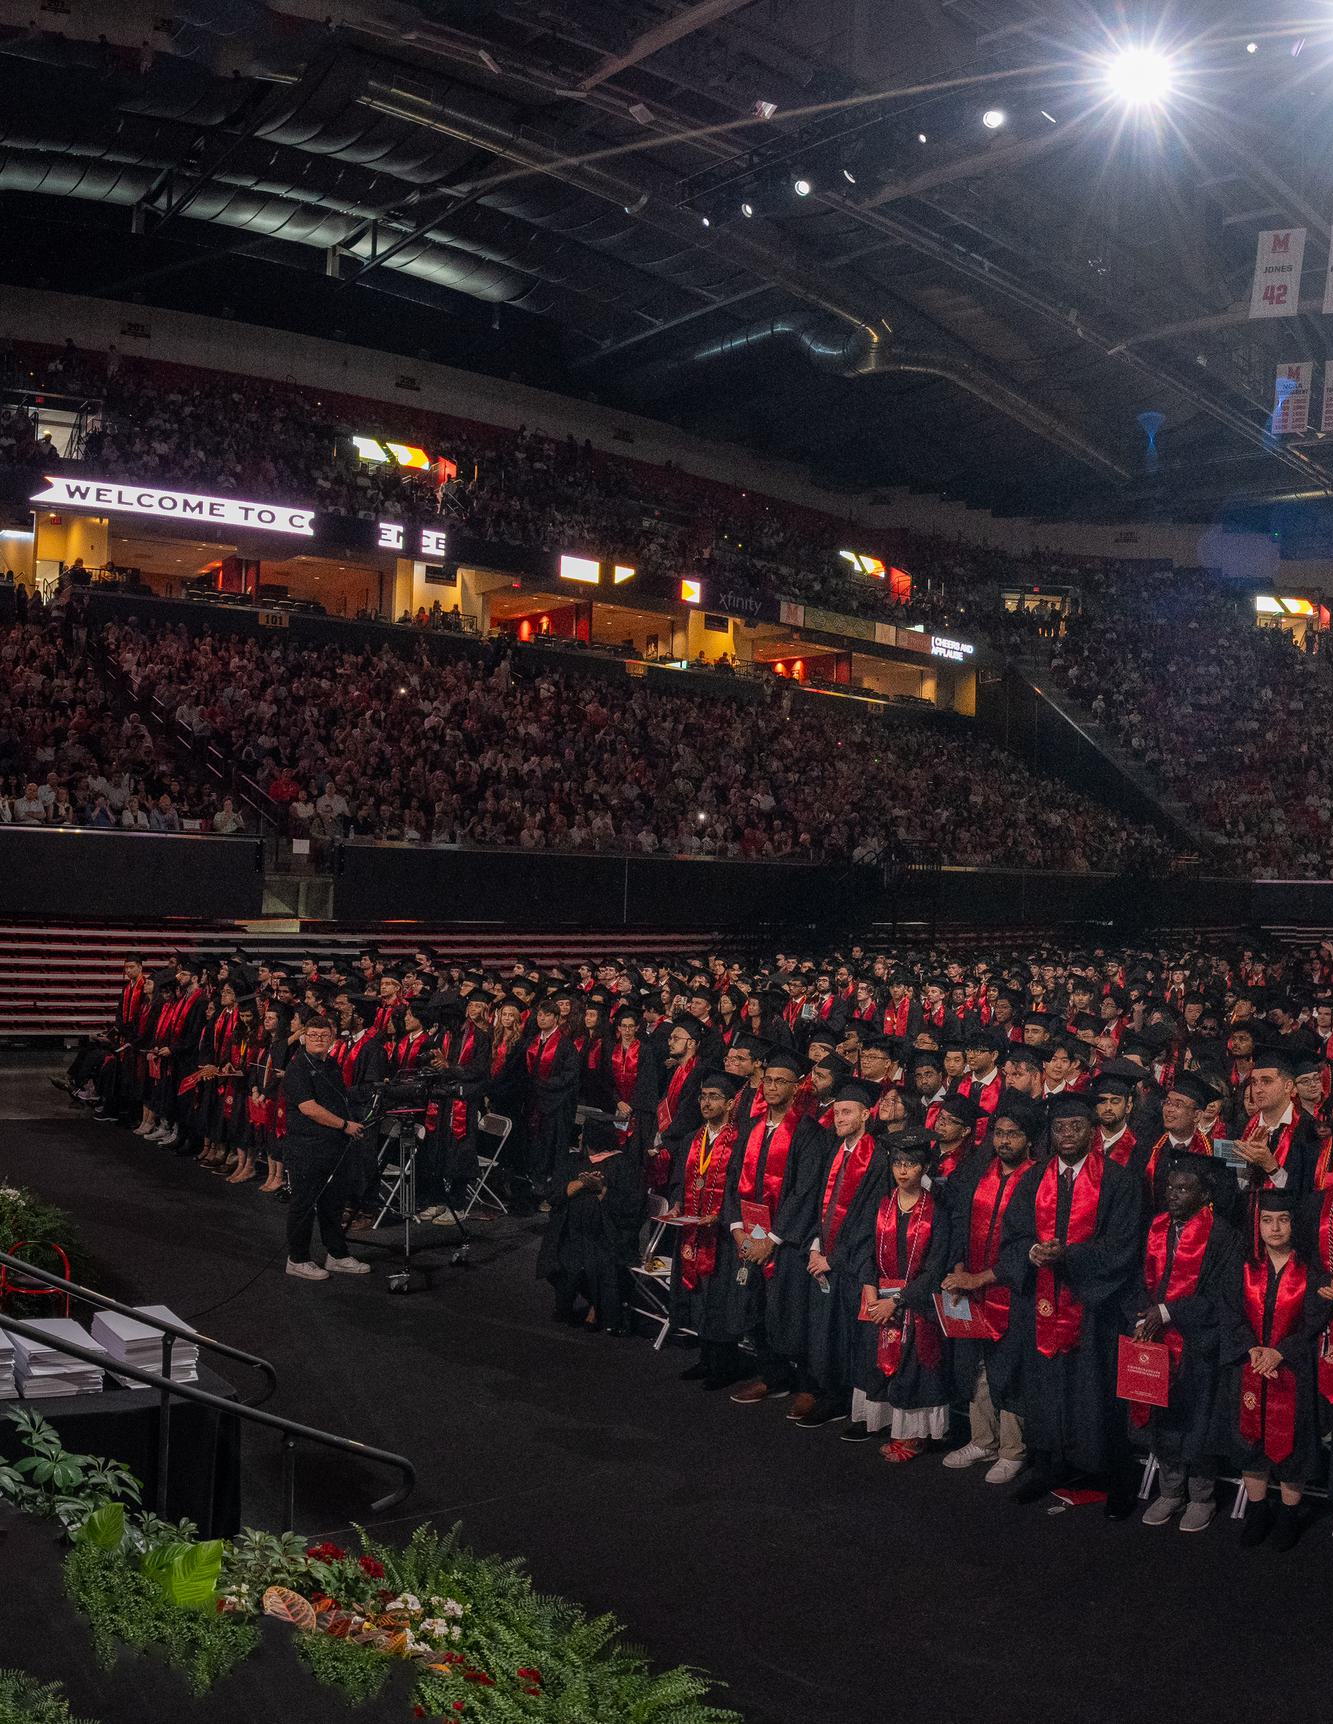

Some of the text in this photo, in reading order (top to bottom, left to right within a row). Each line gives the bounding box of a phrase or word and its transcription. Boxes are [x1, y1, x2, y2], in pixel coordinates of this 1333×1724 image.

[1271, 233, 1291, 253] M
[1263, 265, 1293, 274] JONES
[1262, 284, 1288, 305] 42
[65, 483, 276, 524] WELCOME TO
[719, 590, 762, 616] xfinity
[265, 615, 283, 625] 101
[960, 643, 974, 654] AND
